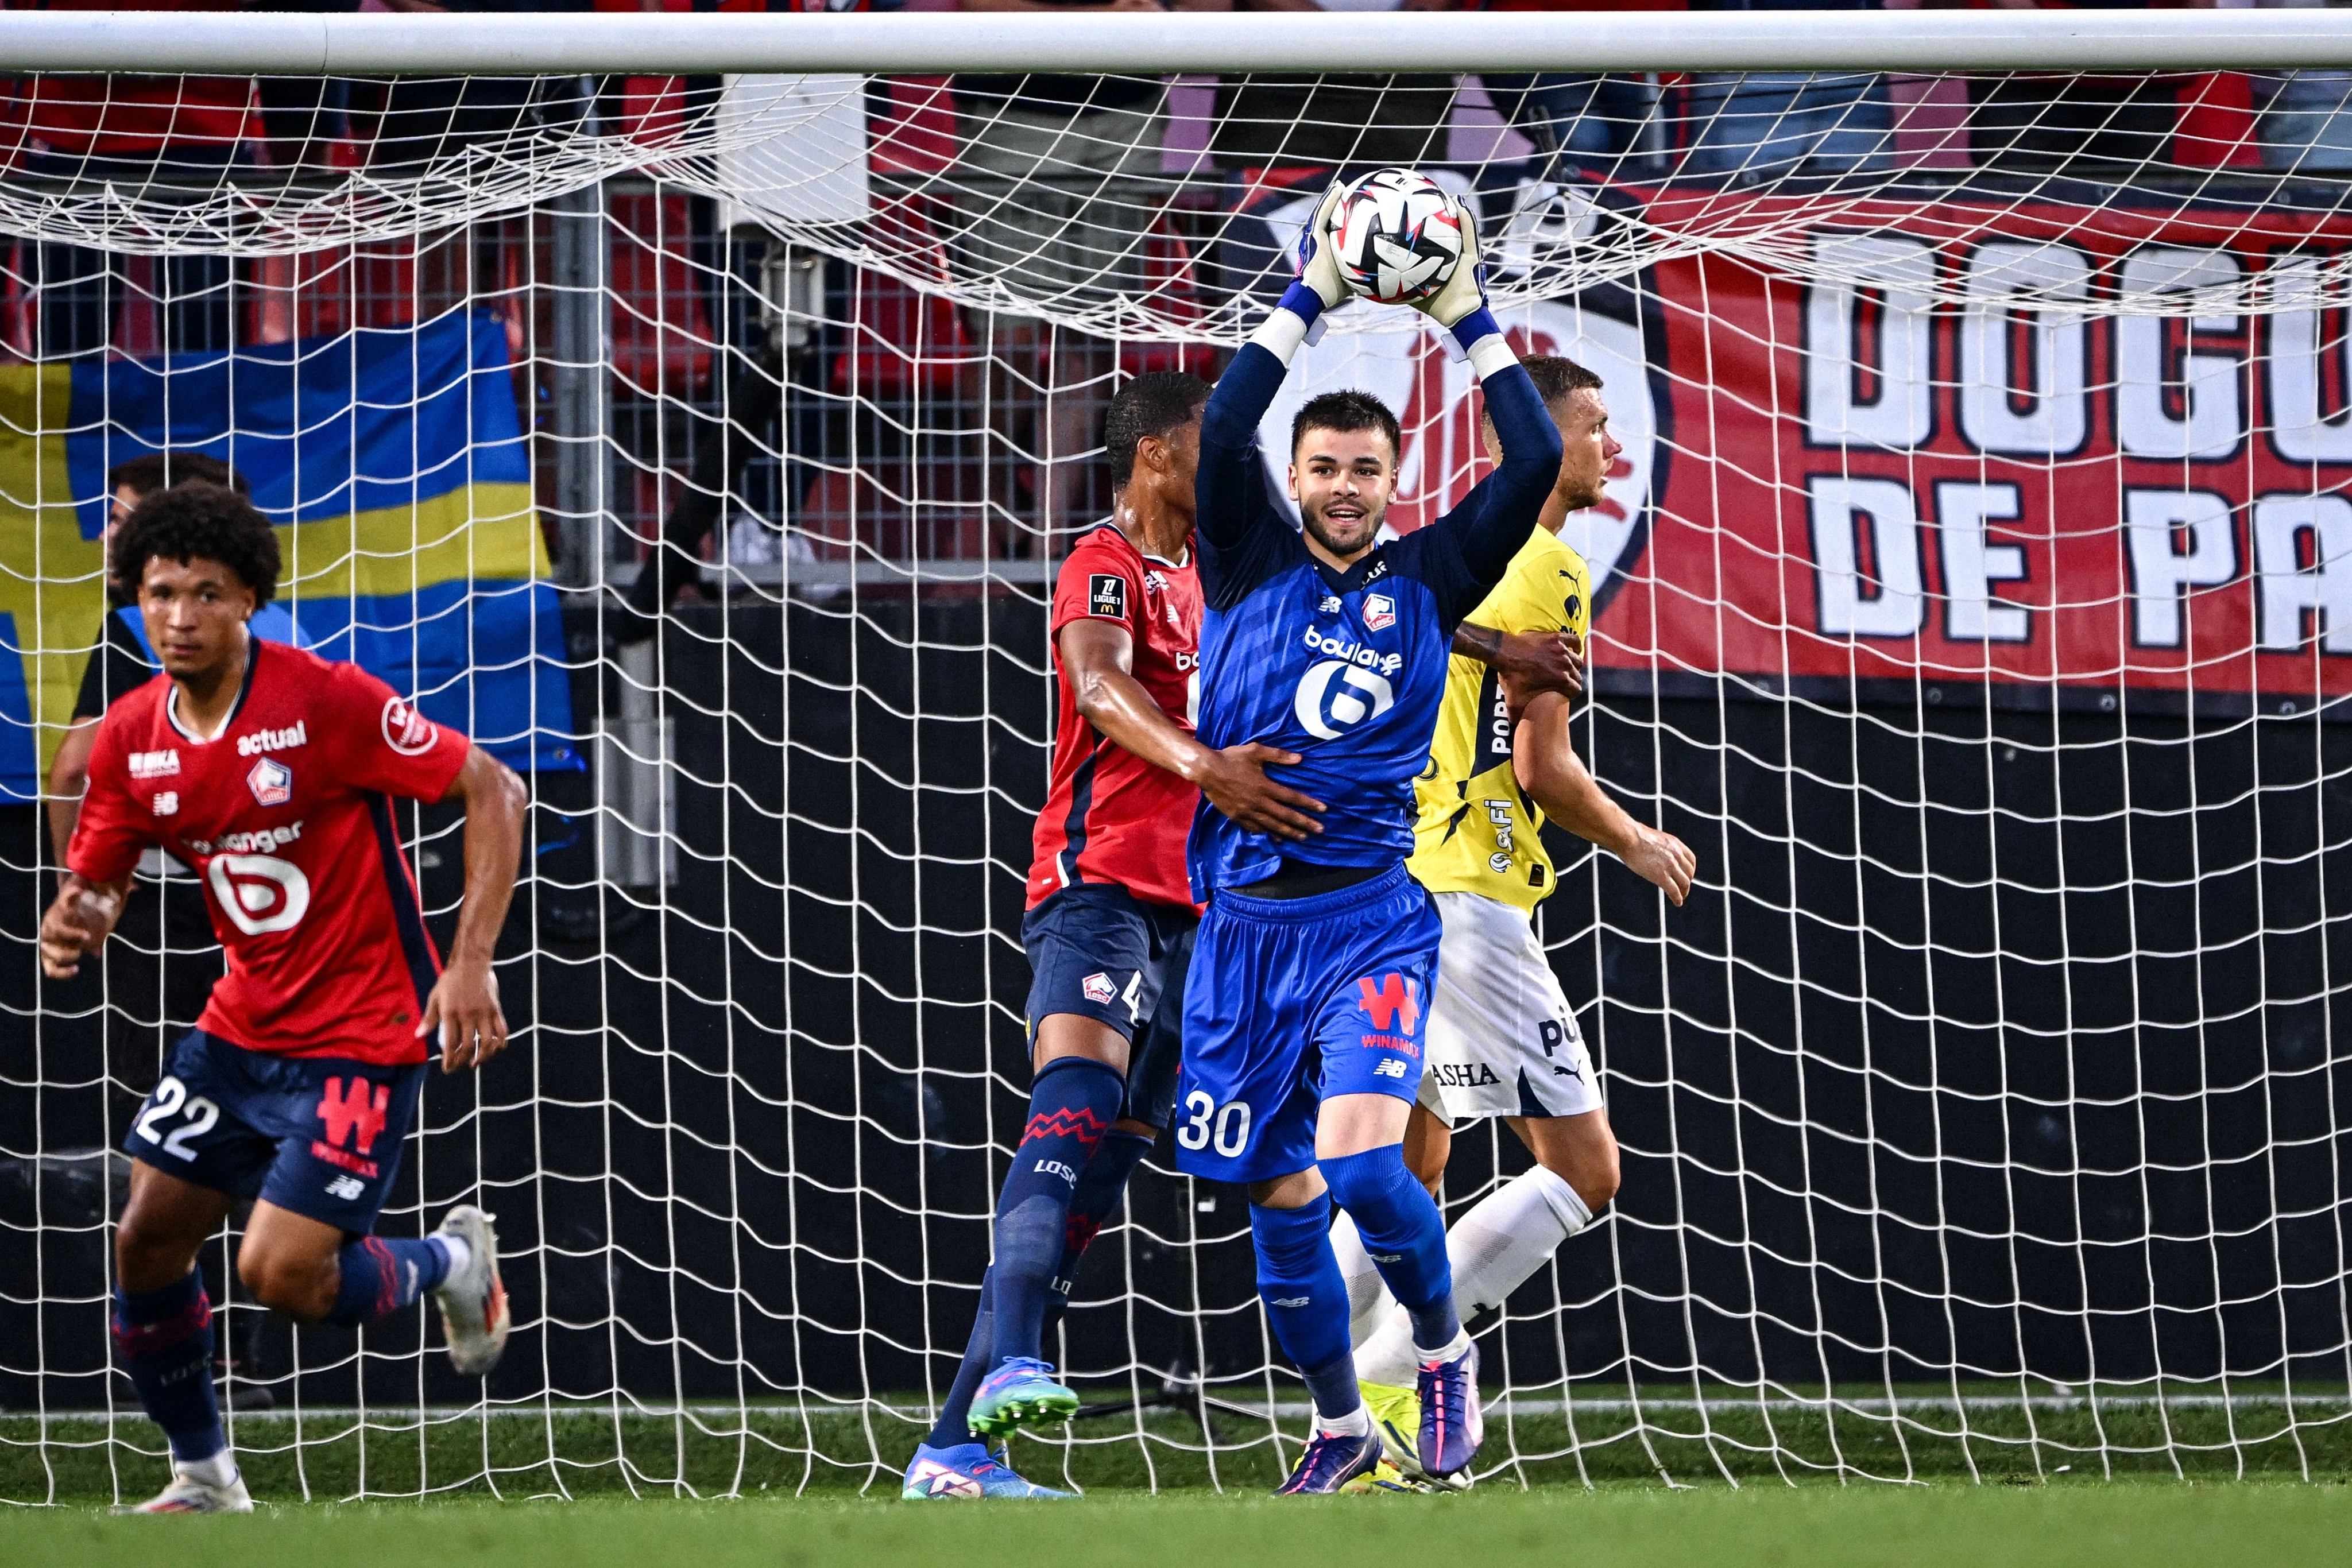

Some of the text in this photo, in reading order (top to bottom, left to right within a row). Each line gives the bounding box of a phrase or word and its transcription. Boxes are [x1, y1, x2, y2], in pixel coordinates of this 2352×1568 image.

[1809, 475, 2352, 655] DE PA
[237, 719, 307, 757] actual
[136, 1075, 220, 1163] 22
[1178, 1090, 1251, 1159] 30
[1034, 1159, 1077, 1190] LOSC
